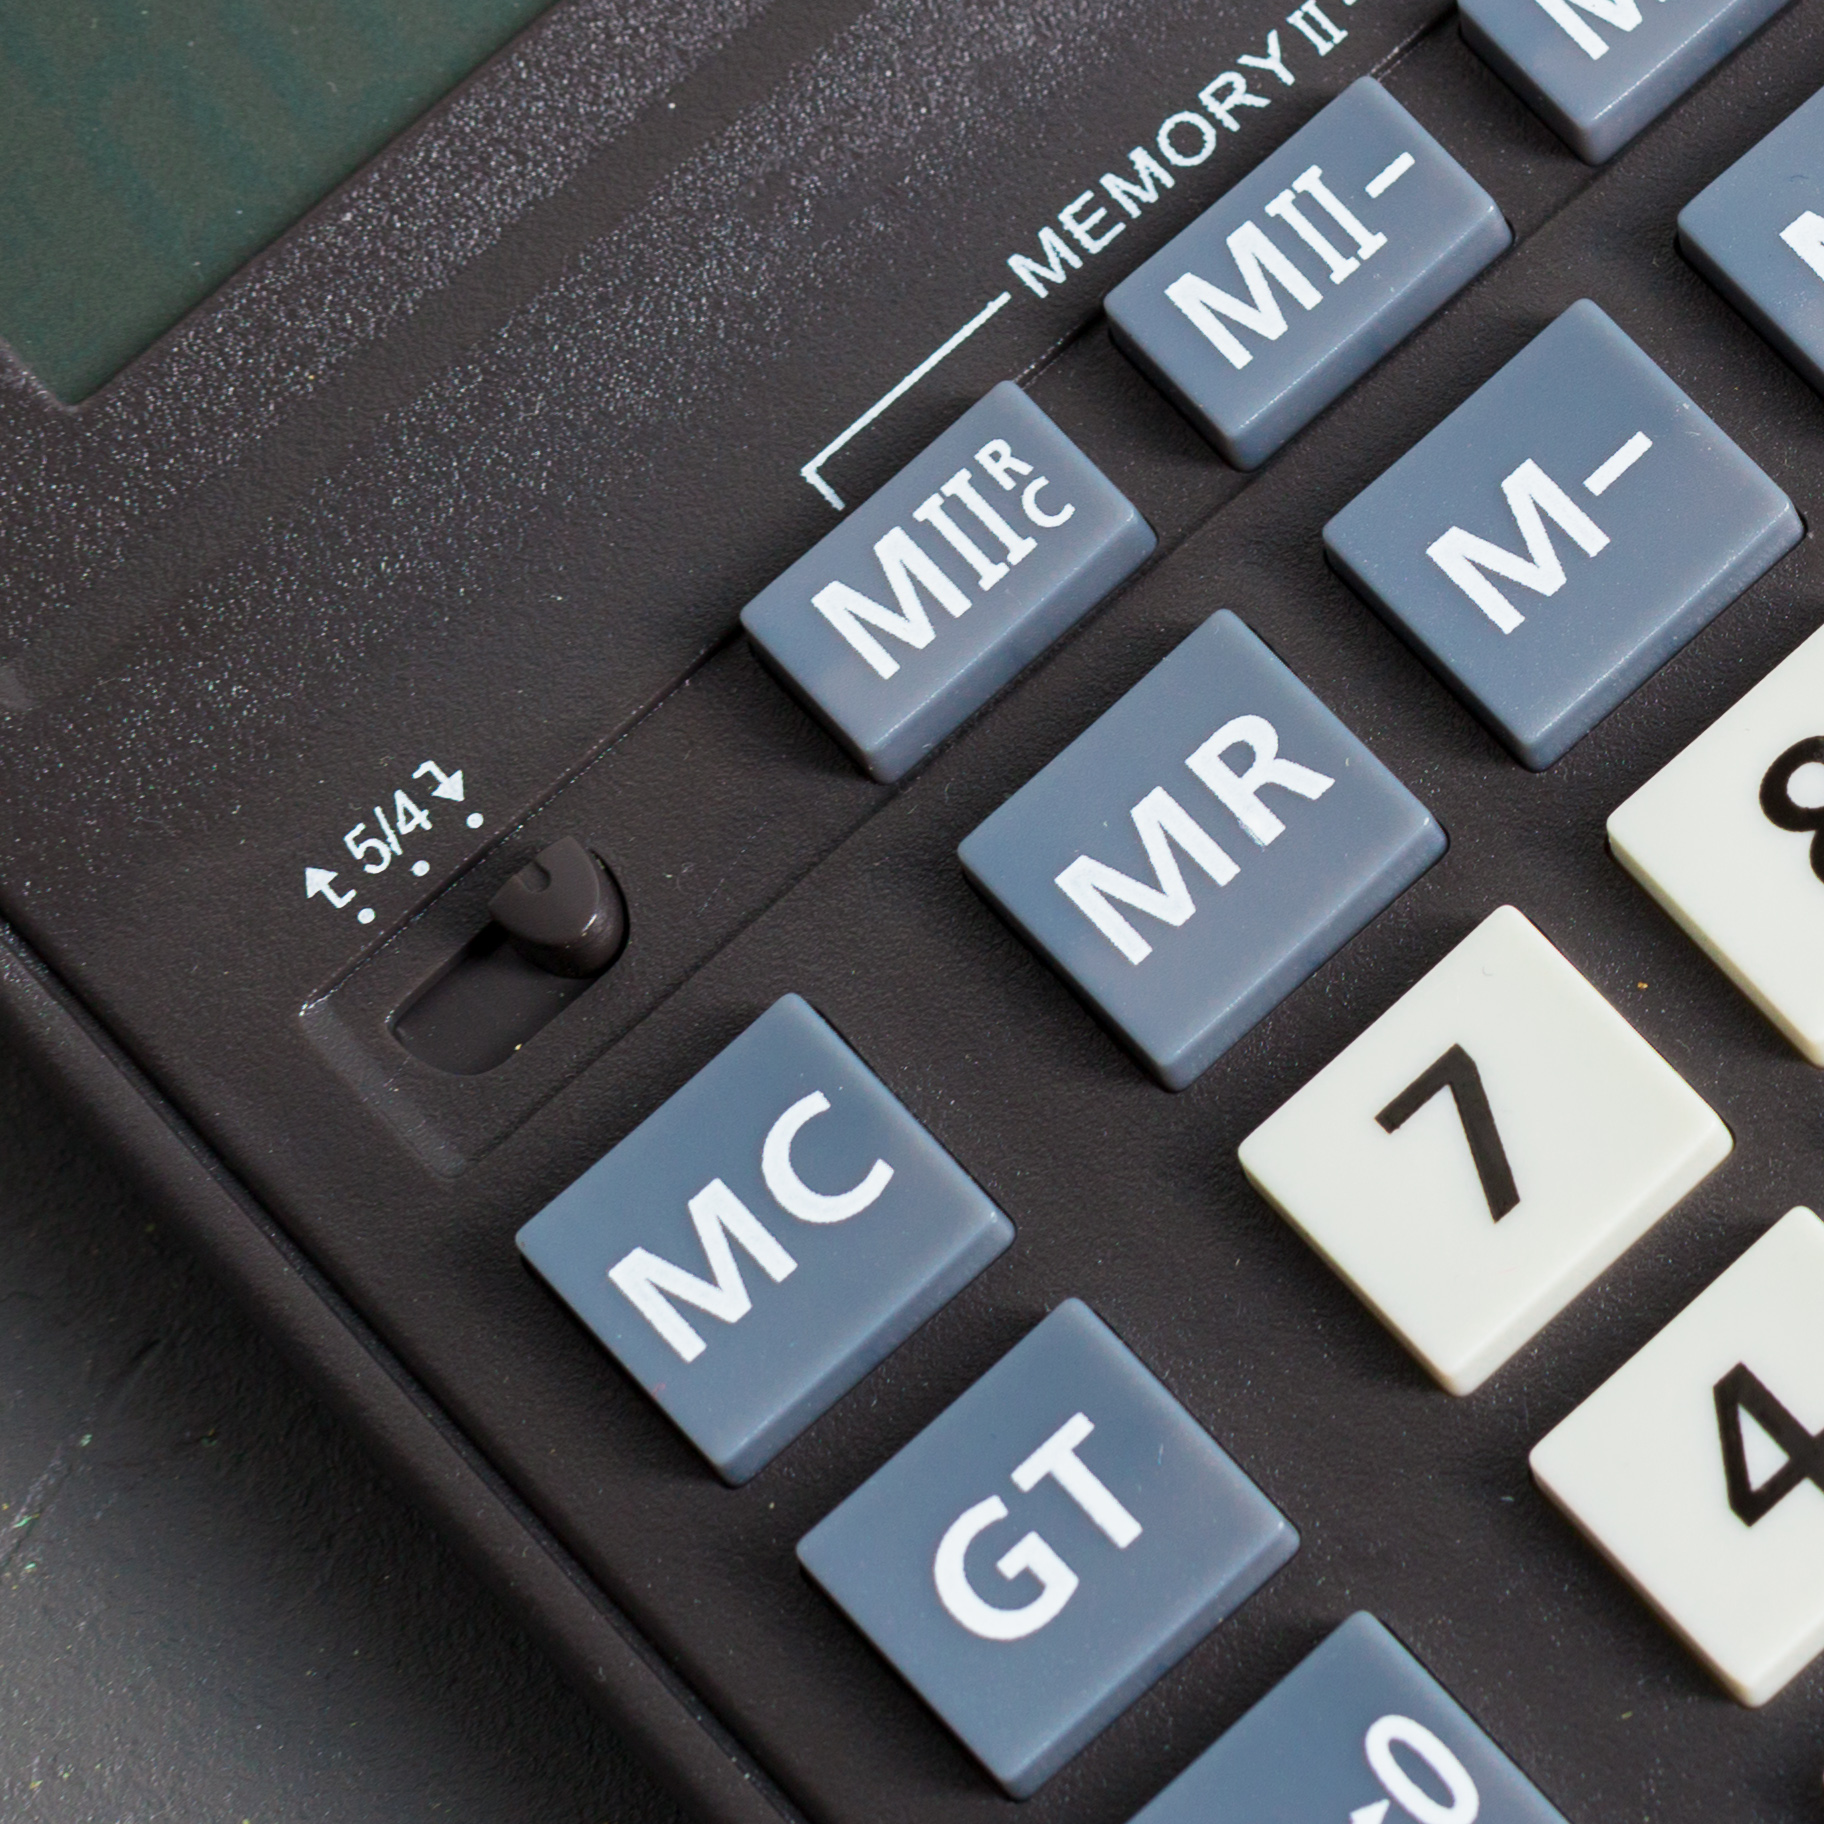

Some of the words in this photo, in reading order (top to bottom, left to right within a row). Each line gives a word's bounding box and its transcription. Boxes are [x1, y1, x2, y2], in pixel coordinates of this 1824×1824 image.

[1007, 29, 1296, 298] MEMORY
[1426, 432, 1652, 634] M-
[1055, 715, 1334, 965] MR
[609, 1091, 893, 1361] MC
[1376, 1045, 1520, 1222] 7
[935, 1413, 1141, 1639] GT
